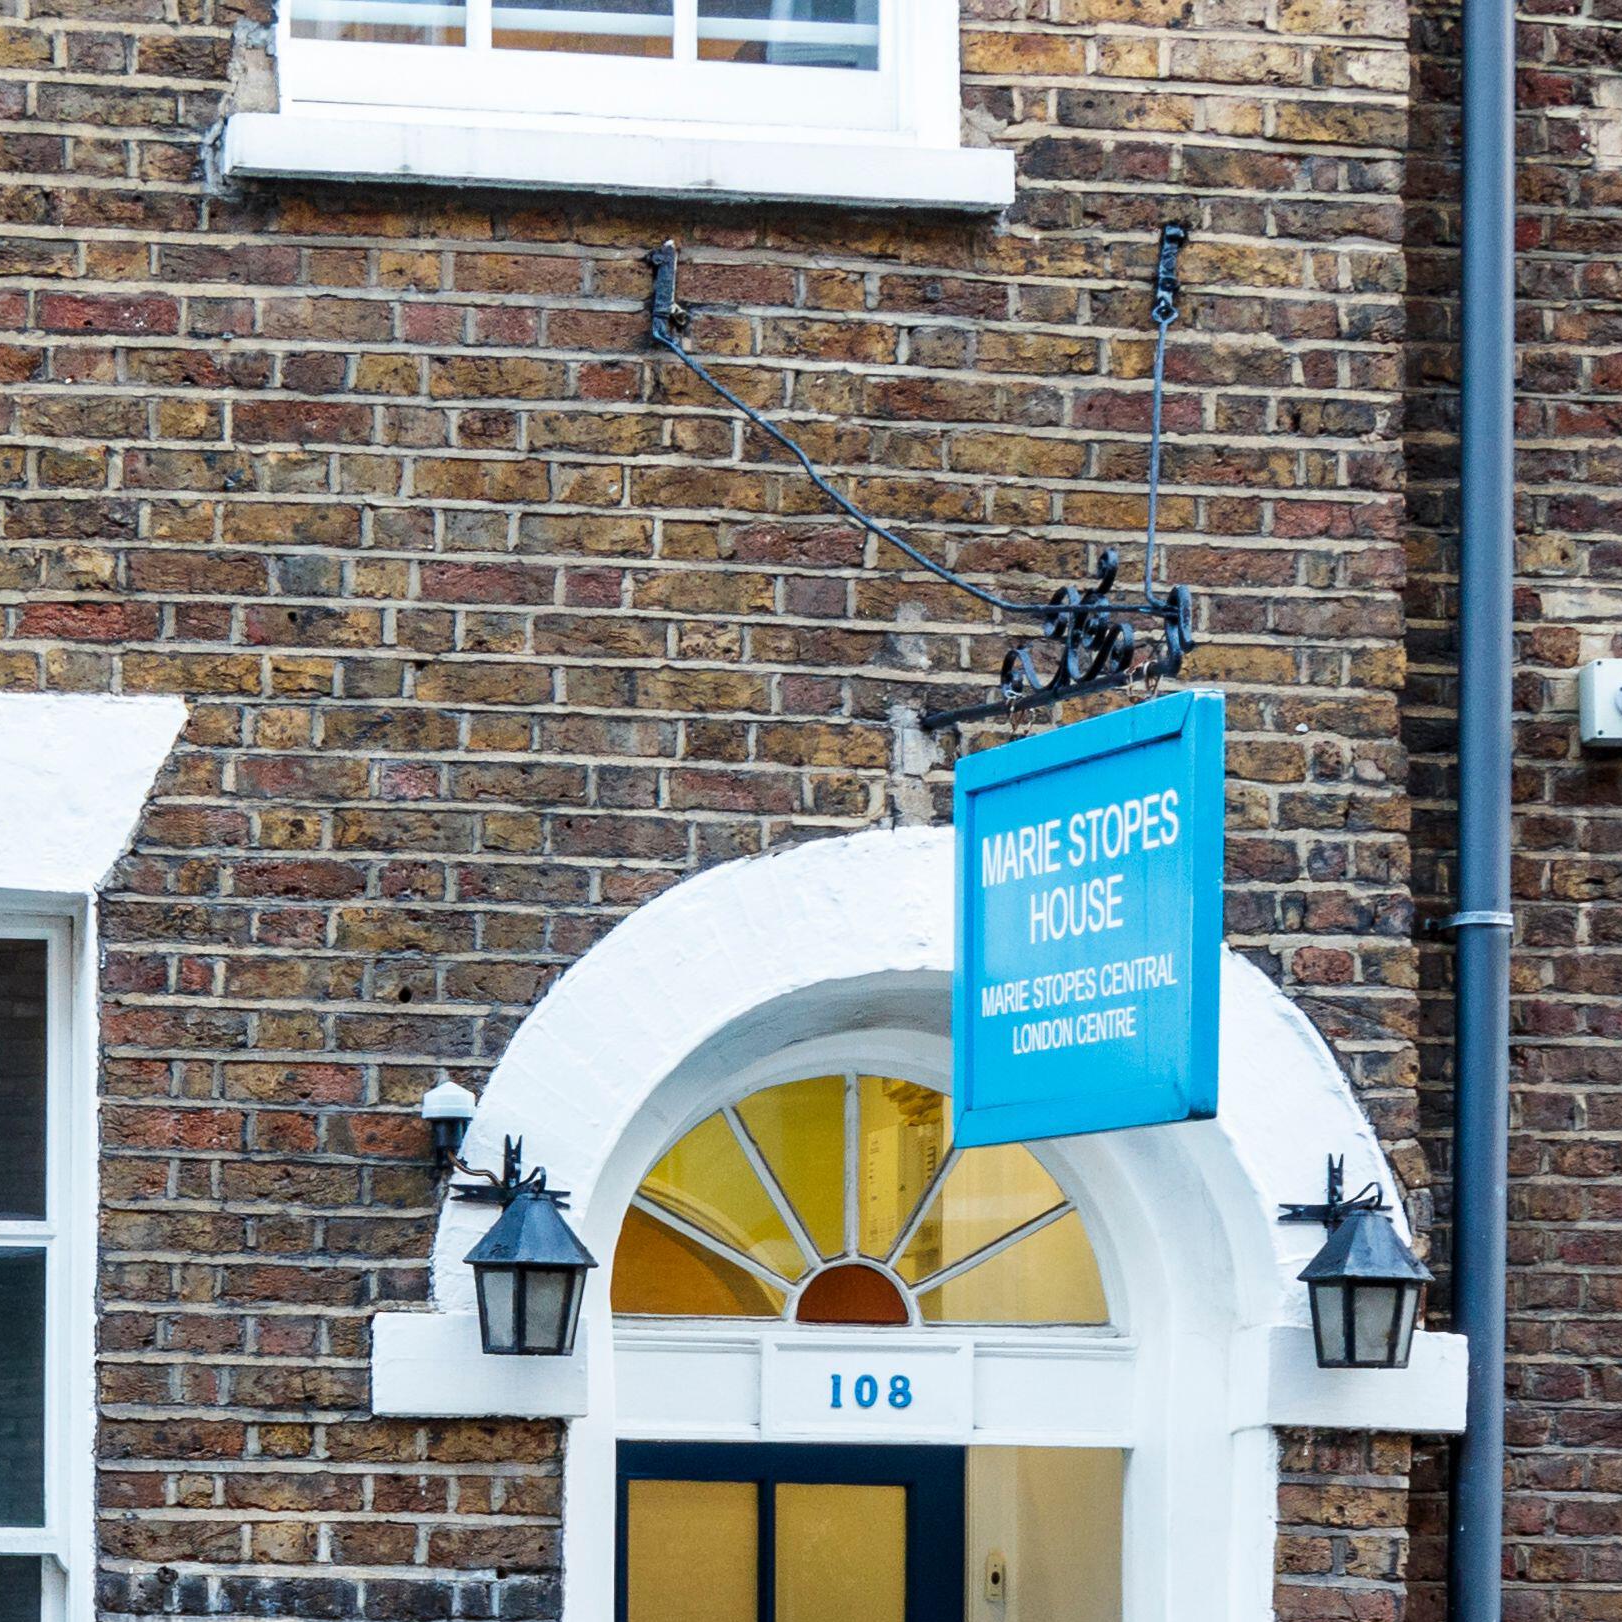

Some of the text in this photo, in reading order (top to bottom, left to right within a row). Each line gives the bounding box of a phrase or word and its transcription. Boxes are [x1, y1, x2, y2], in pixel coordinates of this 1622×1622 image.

[981, 787, 1180, 887] MARIE STOPES
[1029, 874, 1123, 944] HOUSE
[981, 953, 1177, 1018] MARIE STOPES CENTRAL
[1013, 1006, 1137, 1055] LONDON CENTRE
[830, 1373, 913, 1409] 108
